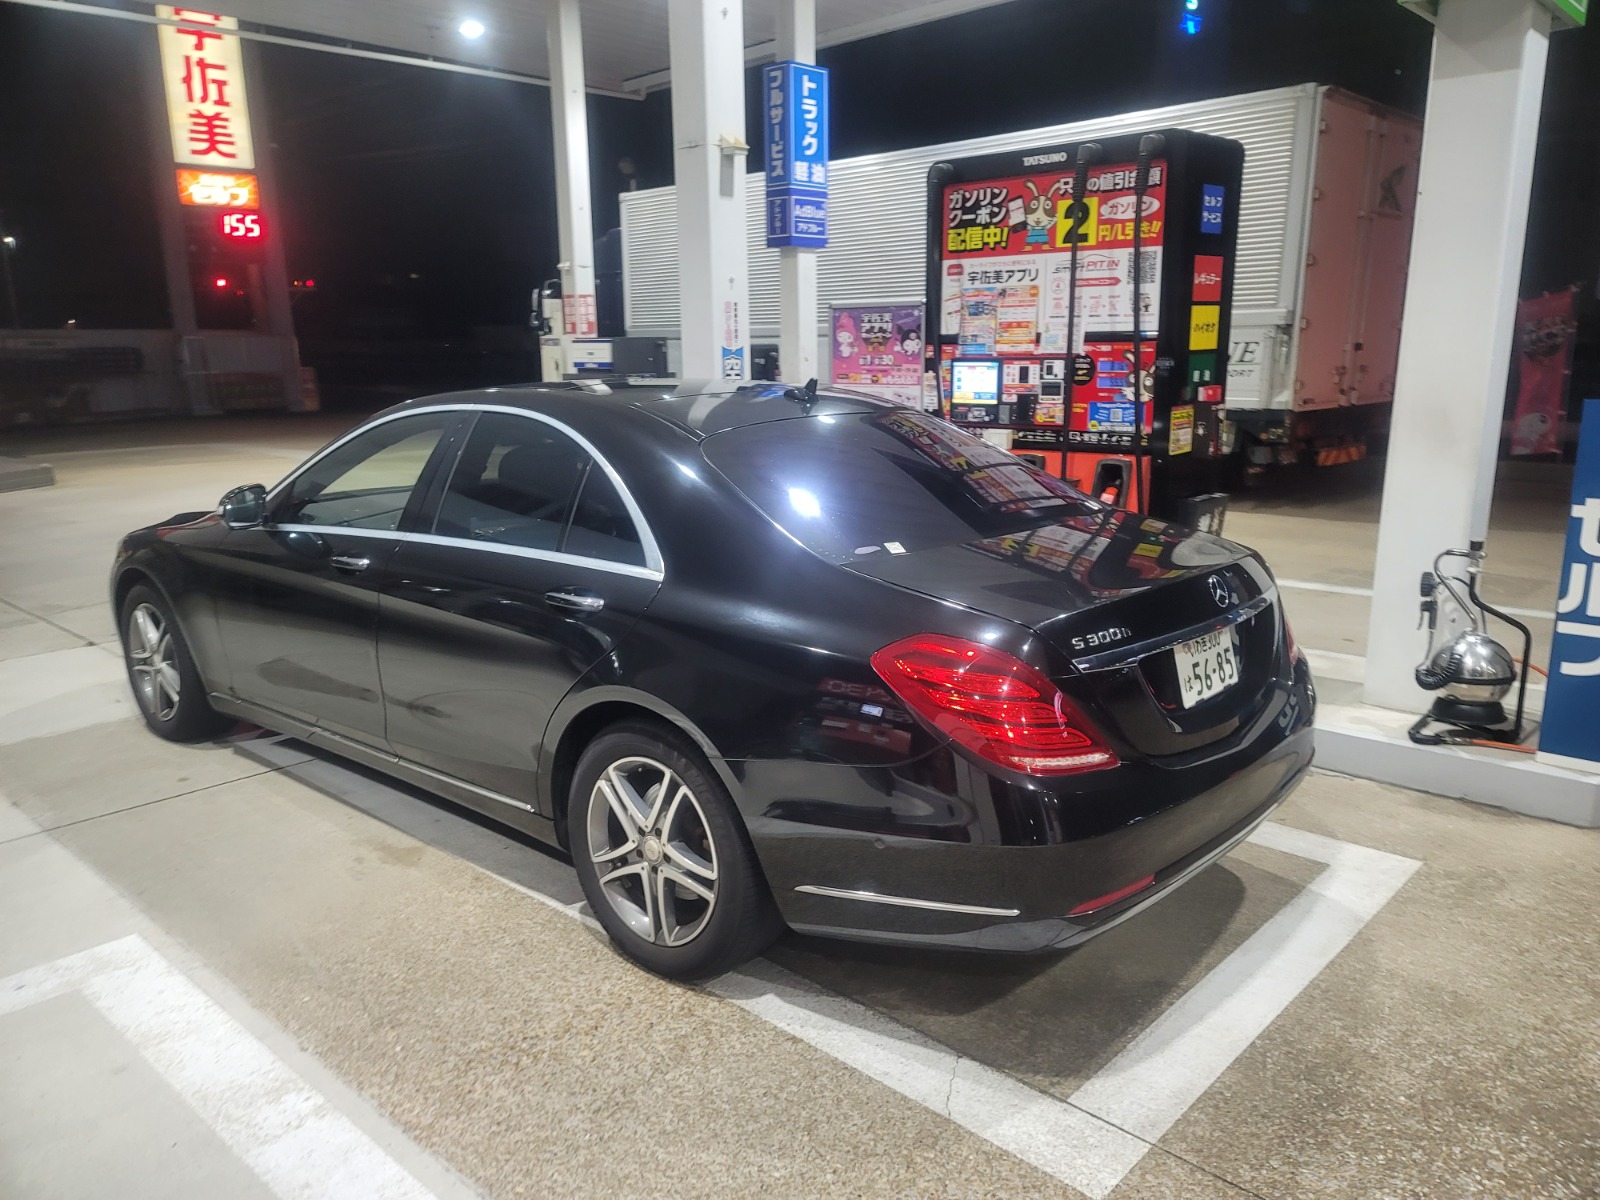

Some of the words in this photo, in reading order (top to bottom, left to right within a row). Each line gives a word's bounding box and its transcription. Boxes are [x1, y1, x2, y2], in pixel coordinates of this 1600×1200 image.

[768, 70, 785, 177] フルサービス
[801, 74, 819, 156] トラック
[1022, 151, 1068, 167] TATSUNO
[949, 187, 1008, 208] ガソリン
[223, 213, 261, 237] 155
[949, 206, 1007, 227] クーポン
[1062, 200, 1090, 244] 2
[947, 225, 1009, 251] 配信中!
[1085, 260, 1106, 270] PIT
[1106, 259, 1121, 268] IN
[967, 268, 1040, 285] 宇佐美アプリ
[1184, 674, 1194, 693] は
